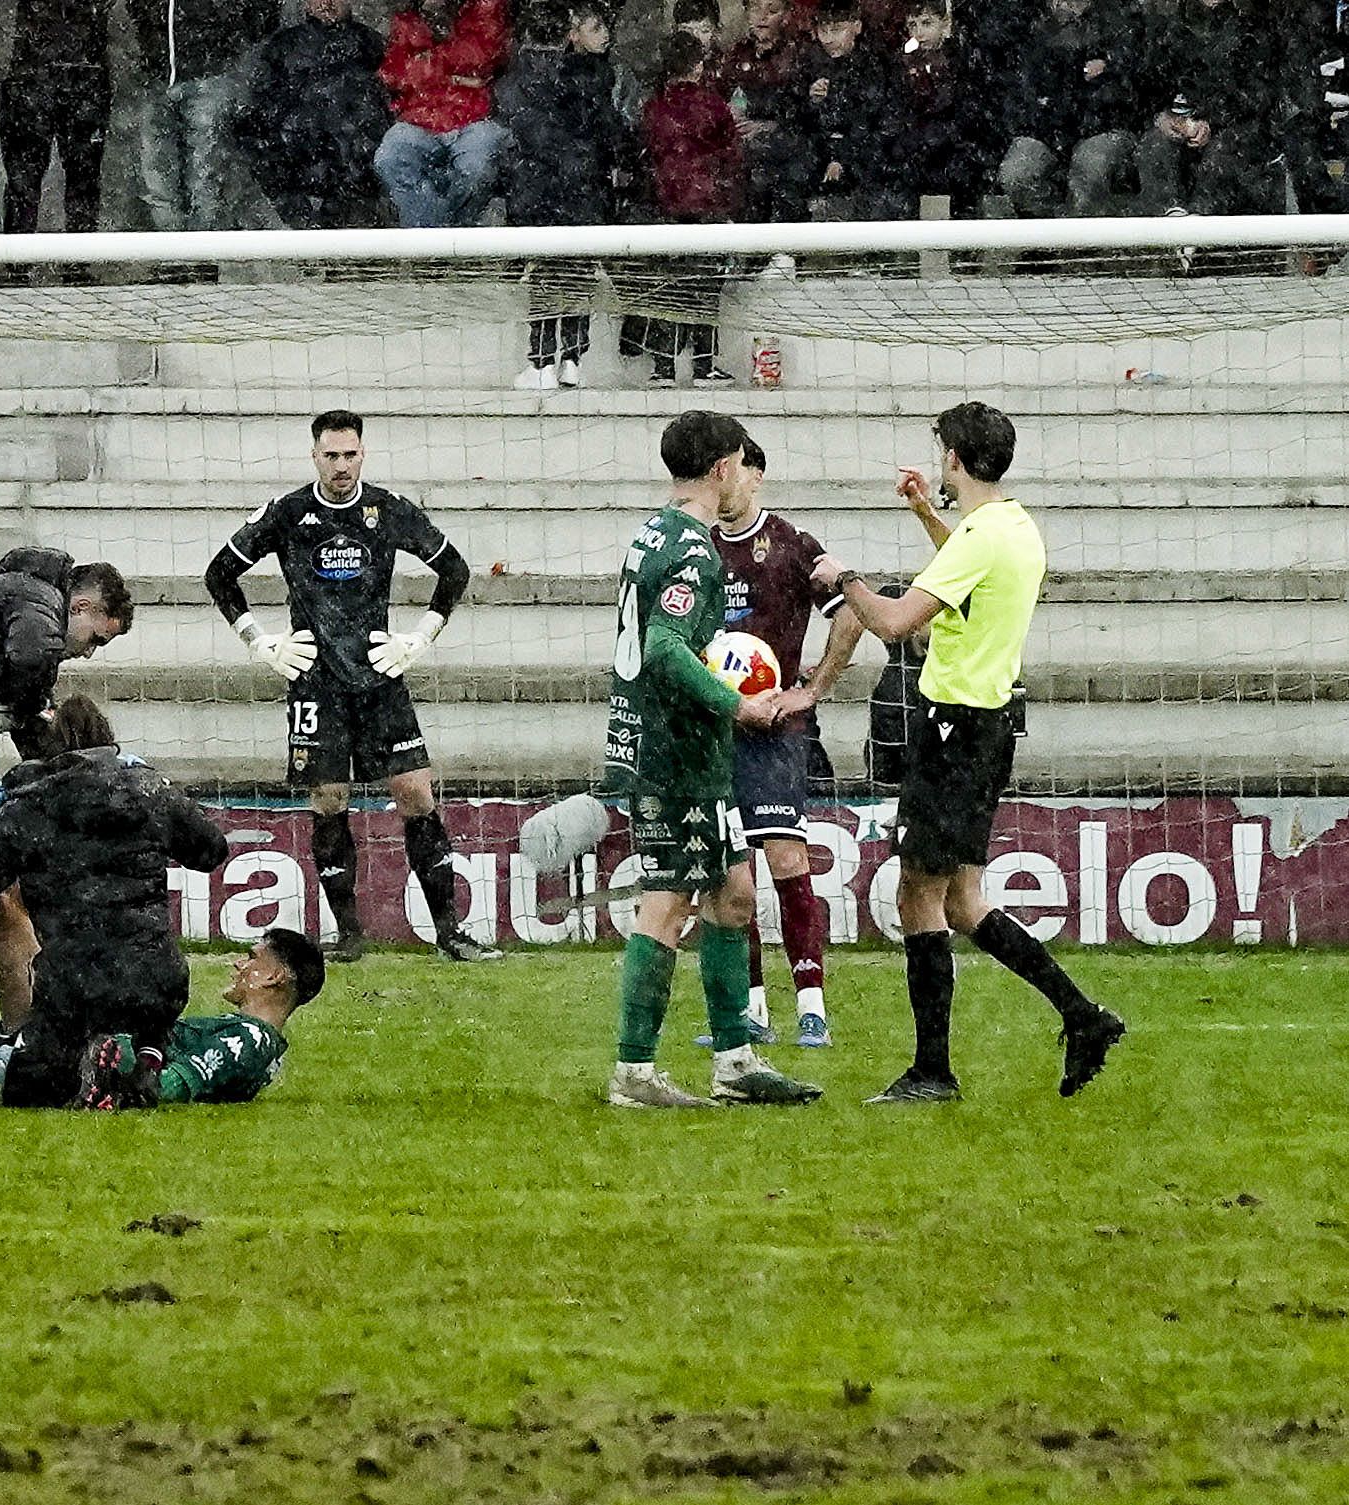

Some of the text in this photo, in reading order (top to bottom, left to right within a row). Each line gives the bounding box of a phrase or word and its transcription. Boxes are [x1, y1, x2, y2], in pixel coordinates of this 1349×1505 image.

[320, 547, 362, 559] Estrella
[322, 558, 361, 569] Galicia
[293, 700, 319, 734] 13
[605, 742, 635, 761] eixe
